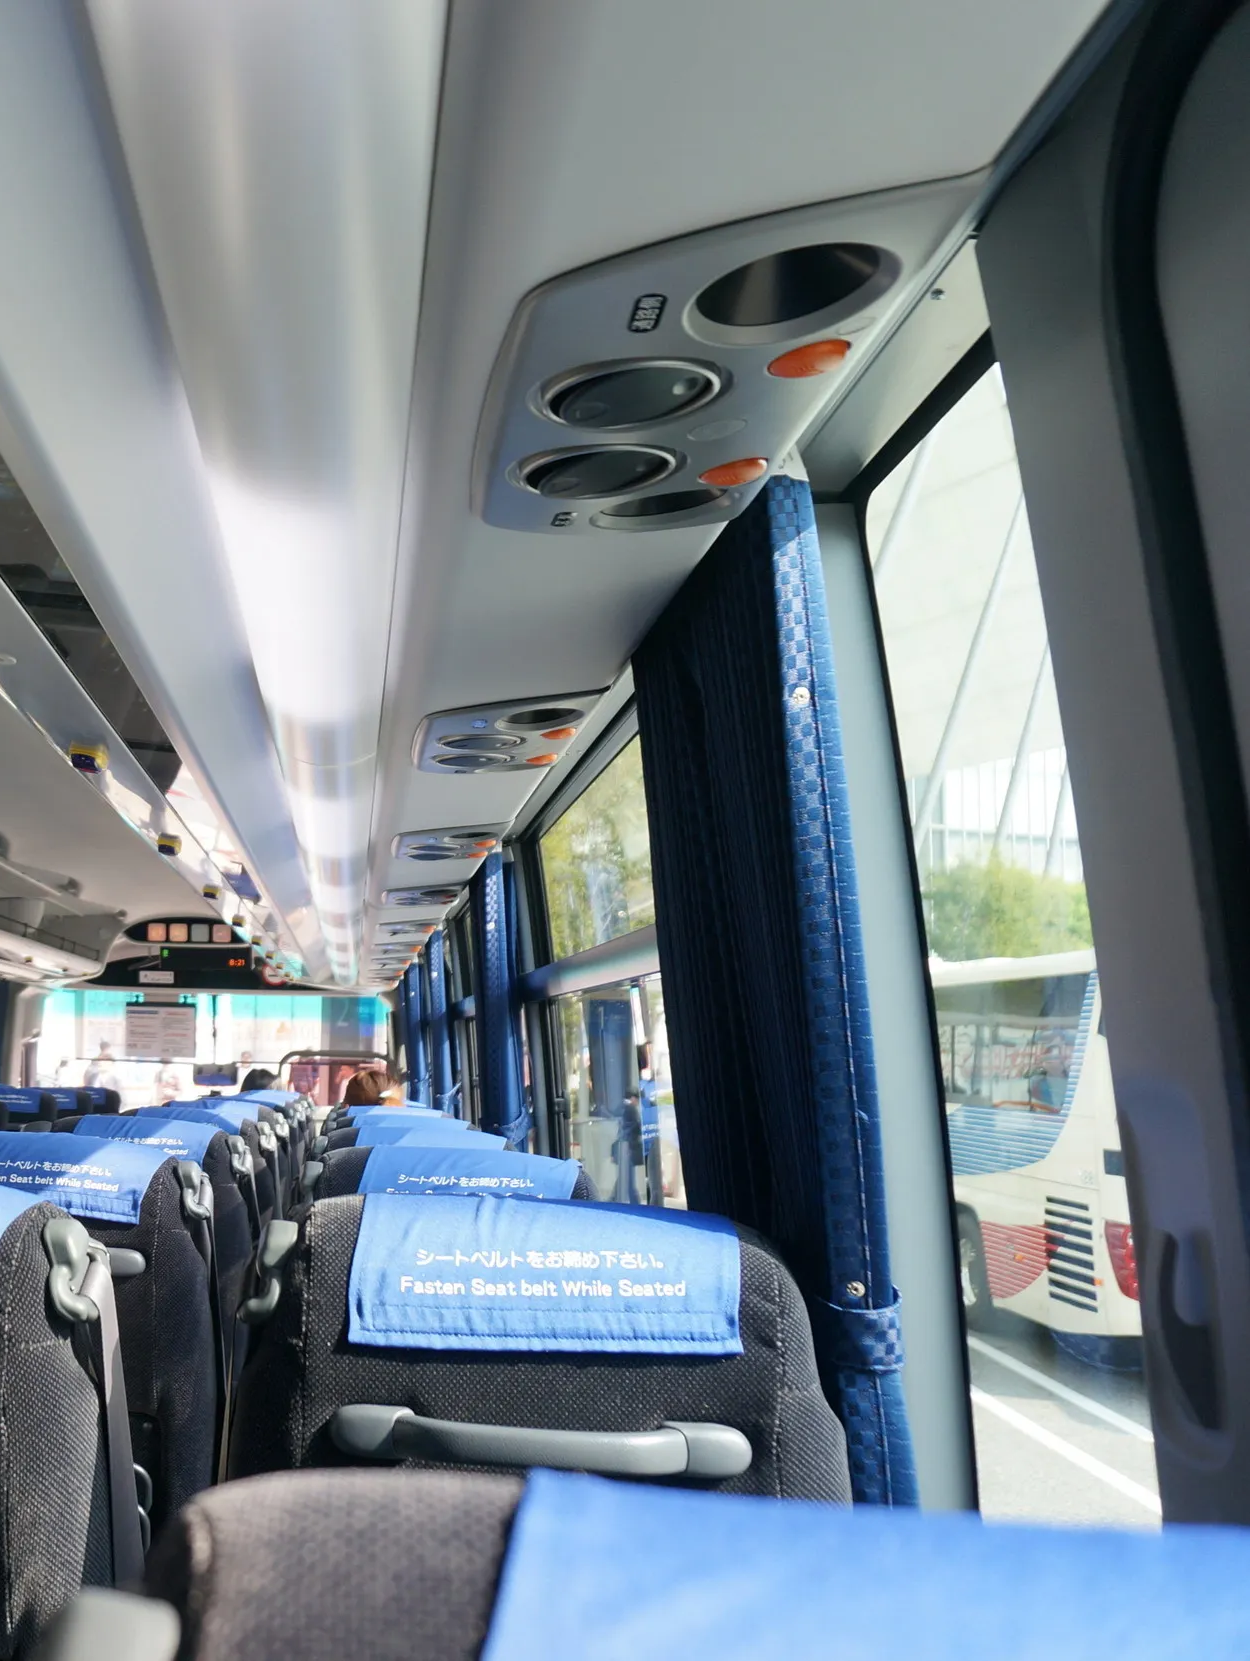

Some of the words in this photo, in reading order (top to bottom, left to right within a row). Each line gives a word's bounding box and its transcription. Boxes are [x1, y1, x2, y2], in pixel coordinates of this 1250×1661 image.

[9, 1173, 33, 1185] Seat
[34, 1175, 53, 1185] belt
[55, 1177, 81, 1187] While
[83, 1180, 119, 1192] Seated
[415, 1249, 664, 1270] シートベルトをお締め下さい。
[400, 1276, 465, 1295] Fasten
[471, 1278, 516, 1297] Seat
[521, 1279, 558, 1297] belt
[562, 1279, 613, 1297] While
[618, 1279, 686, 1297] Seated
